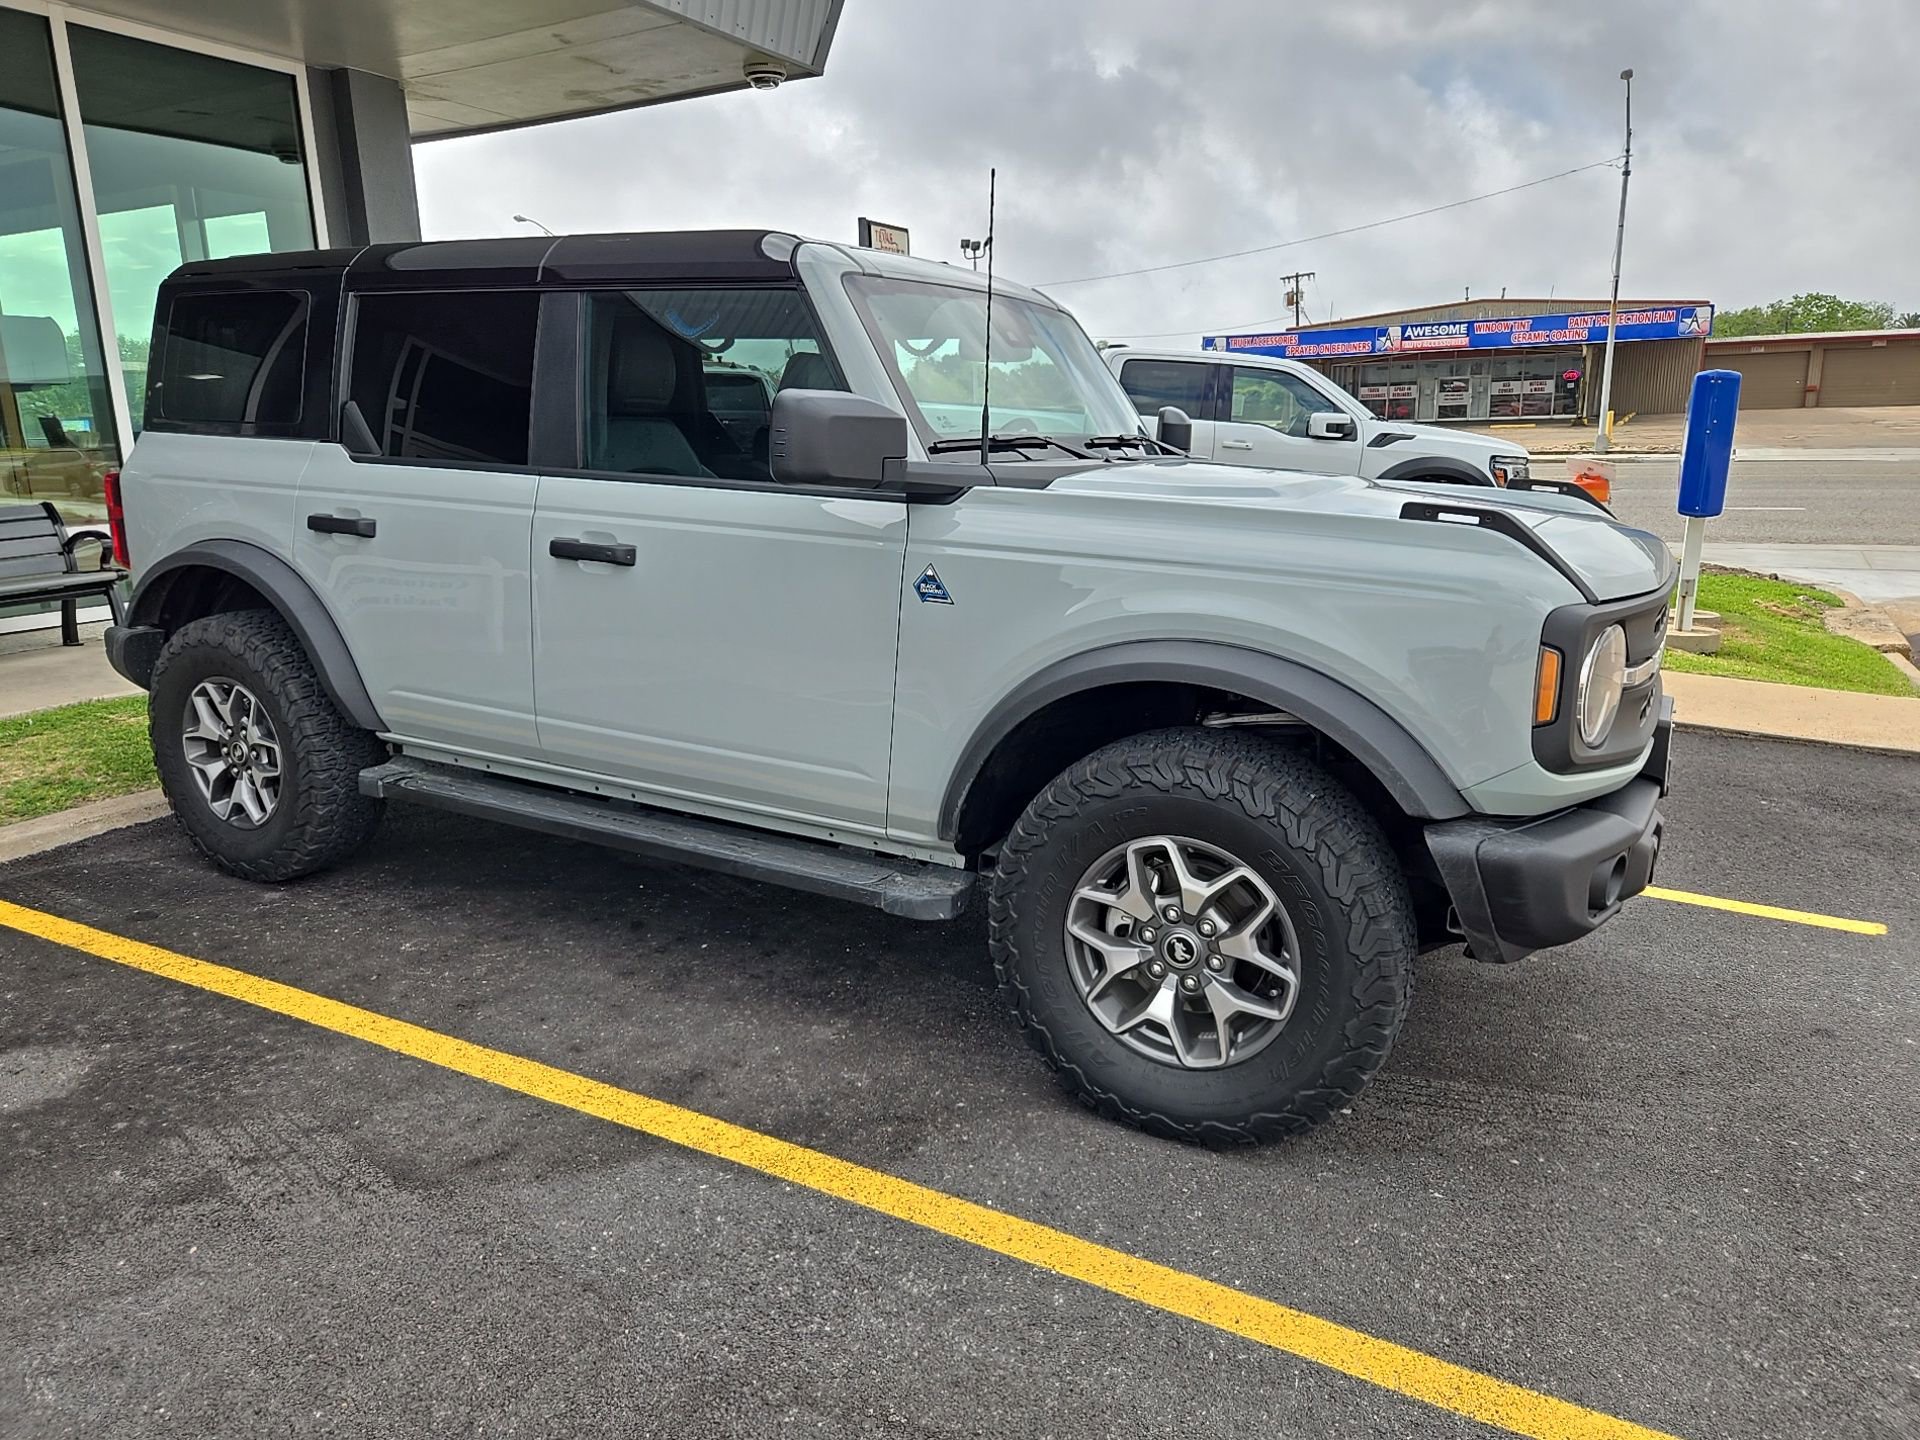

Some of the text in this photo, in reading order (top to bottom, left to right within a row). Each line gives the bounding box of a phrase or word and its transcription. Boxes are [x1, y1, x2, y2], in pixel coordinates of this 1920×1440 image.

[1568, 316, 1595, 328] PAINT
[1653, 310, 1676, 323] FILM
[1404, 324, 1468, 339] AWESOME
[1474, 320, 1532, 334] WINDOW TINT
[1229, 335, 1298, 348] TRUCK ACCESSORIES
[1511, 329, 1588, 343] CERAMIC COATING
[1286, 341, 1372, 356] SPRAYED ON BEDLINERS
